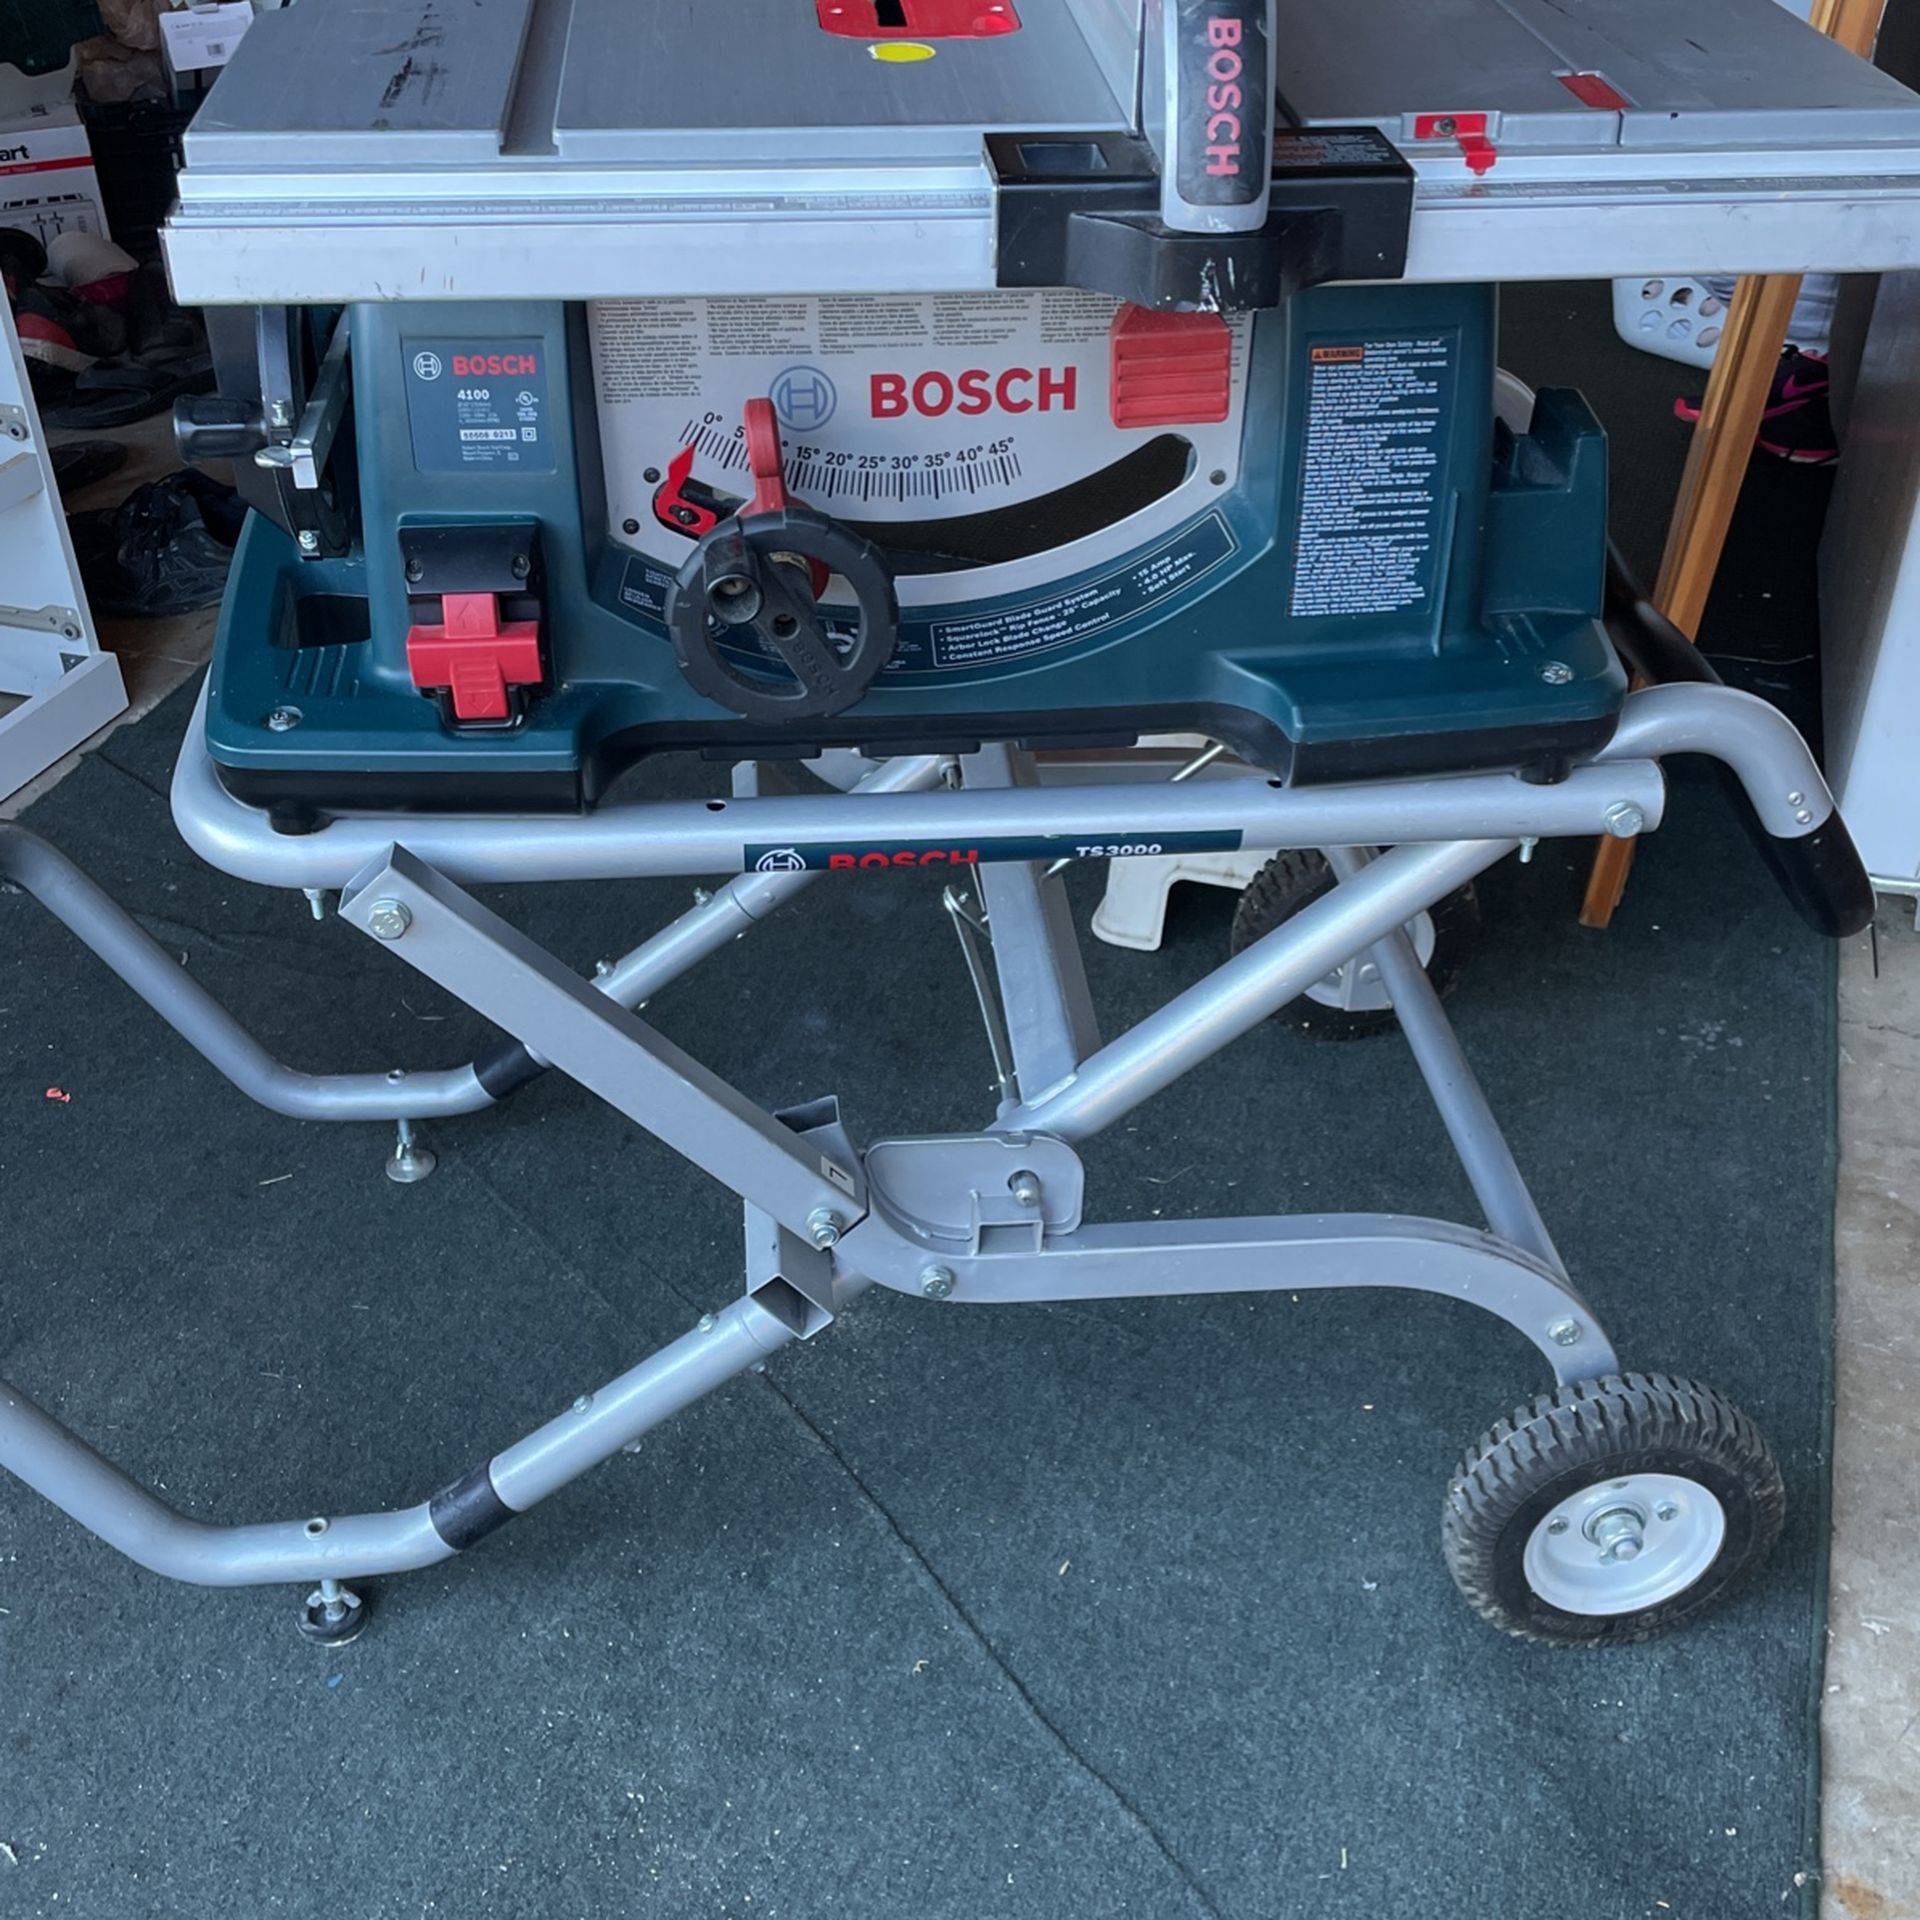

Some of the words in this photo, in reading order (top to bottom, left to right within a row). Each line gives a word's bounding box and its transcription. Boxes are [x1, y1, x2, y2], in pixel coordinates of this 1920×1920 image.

[1205, 17, 1242, 176] BOSCH
[452, 355, 535, 375] BOSCH
[457, 389, 490, 401] 4100
[870, 366, 1077, 418] BOSCH
[796, 446, 821, 460] 15°
[826, 451, 853, 466] 20°
[858, 456, 886, 469] 25°
[891, 456, 919, 469] 30°
[924, 452, 951, 468] 35°
[956, 445, 983, 463] 40°
[988, 436, 1015, 457] 45°
[1168, 564, 1191, 581] Start
[1033, 602, 1063, 616] Guard
[1064, 589, 1098, 606] System
[1081, 588, 1121, 609] Capacity
[948, 642, 975, 651] Arbor
[977, 638, 1000, 647] Lock
[1031, 620, 1067, 635] Change
[949, 649, 993, 660] Constant
[995, 638, 1041, 653] Response
[1043, 627, 1073, 642] Speed
[1074, 612, 1110, 631] Control
[1075, 844, 1162, 857] TS3000
